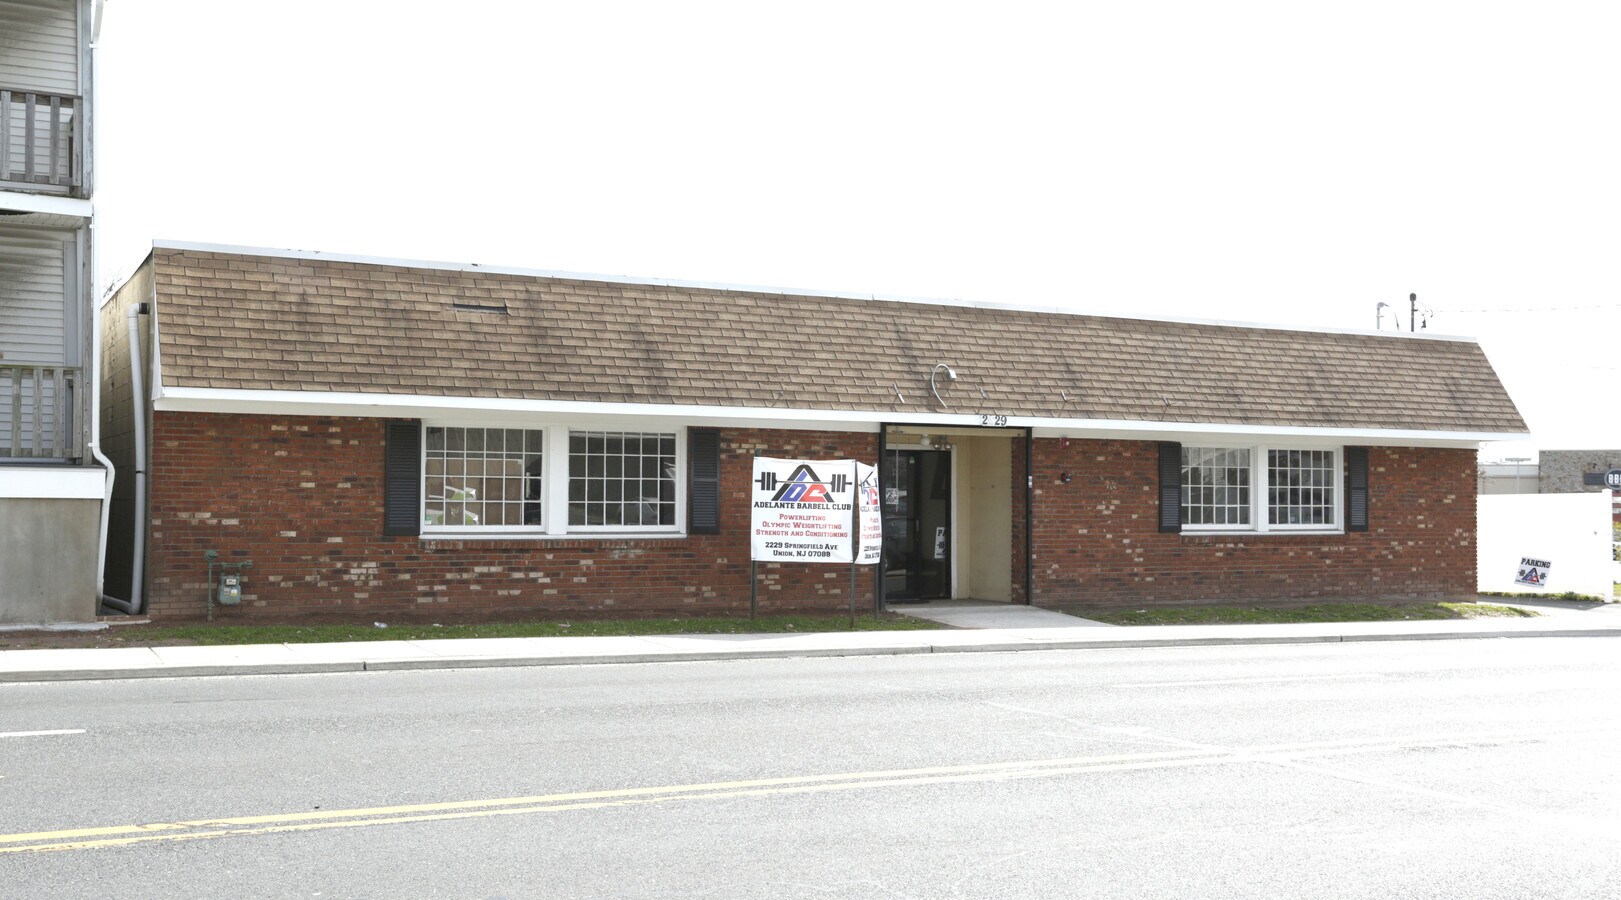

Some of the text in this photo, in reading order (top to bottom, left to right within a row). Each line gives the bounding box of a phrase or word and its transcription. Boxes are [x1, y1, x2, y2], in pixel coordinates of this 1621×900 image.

[754, 501, 795, 509] ADELANTE
[832, 503, 852, 511] CLUB
[779, 513, 826, 521] POWERLIFTING
[793, 522, 842, 530] WEIGHTLIFTING
[755, 529, 789, 537] STRENGTH
[805, 530, 848, 538] CONDITIONING
[765, 541, 783, 549] 2229
[784, 542, 823, 550] SPRINGFIELD
[1521, 558, 1551, 568] PARKING
